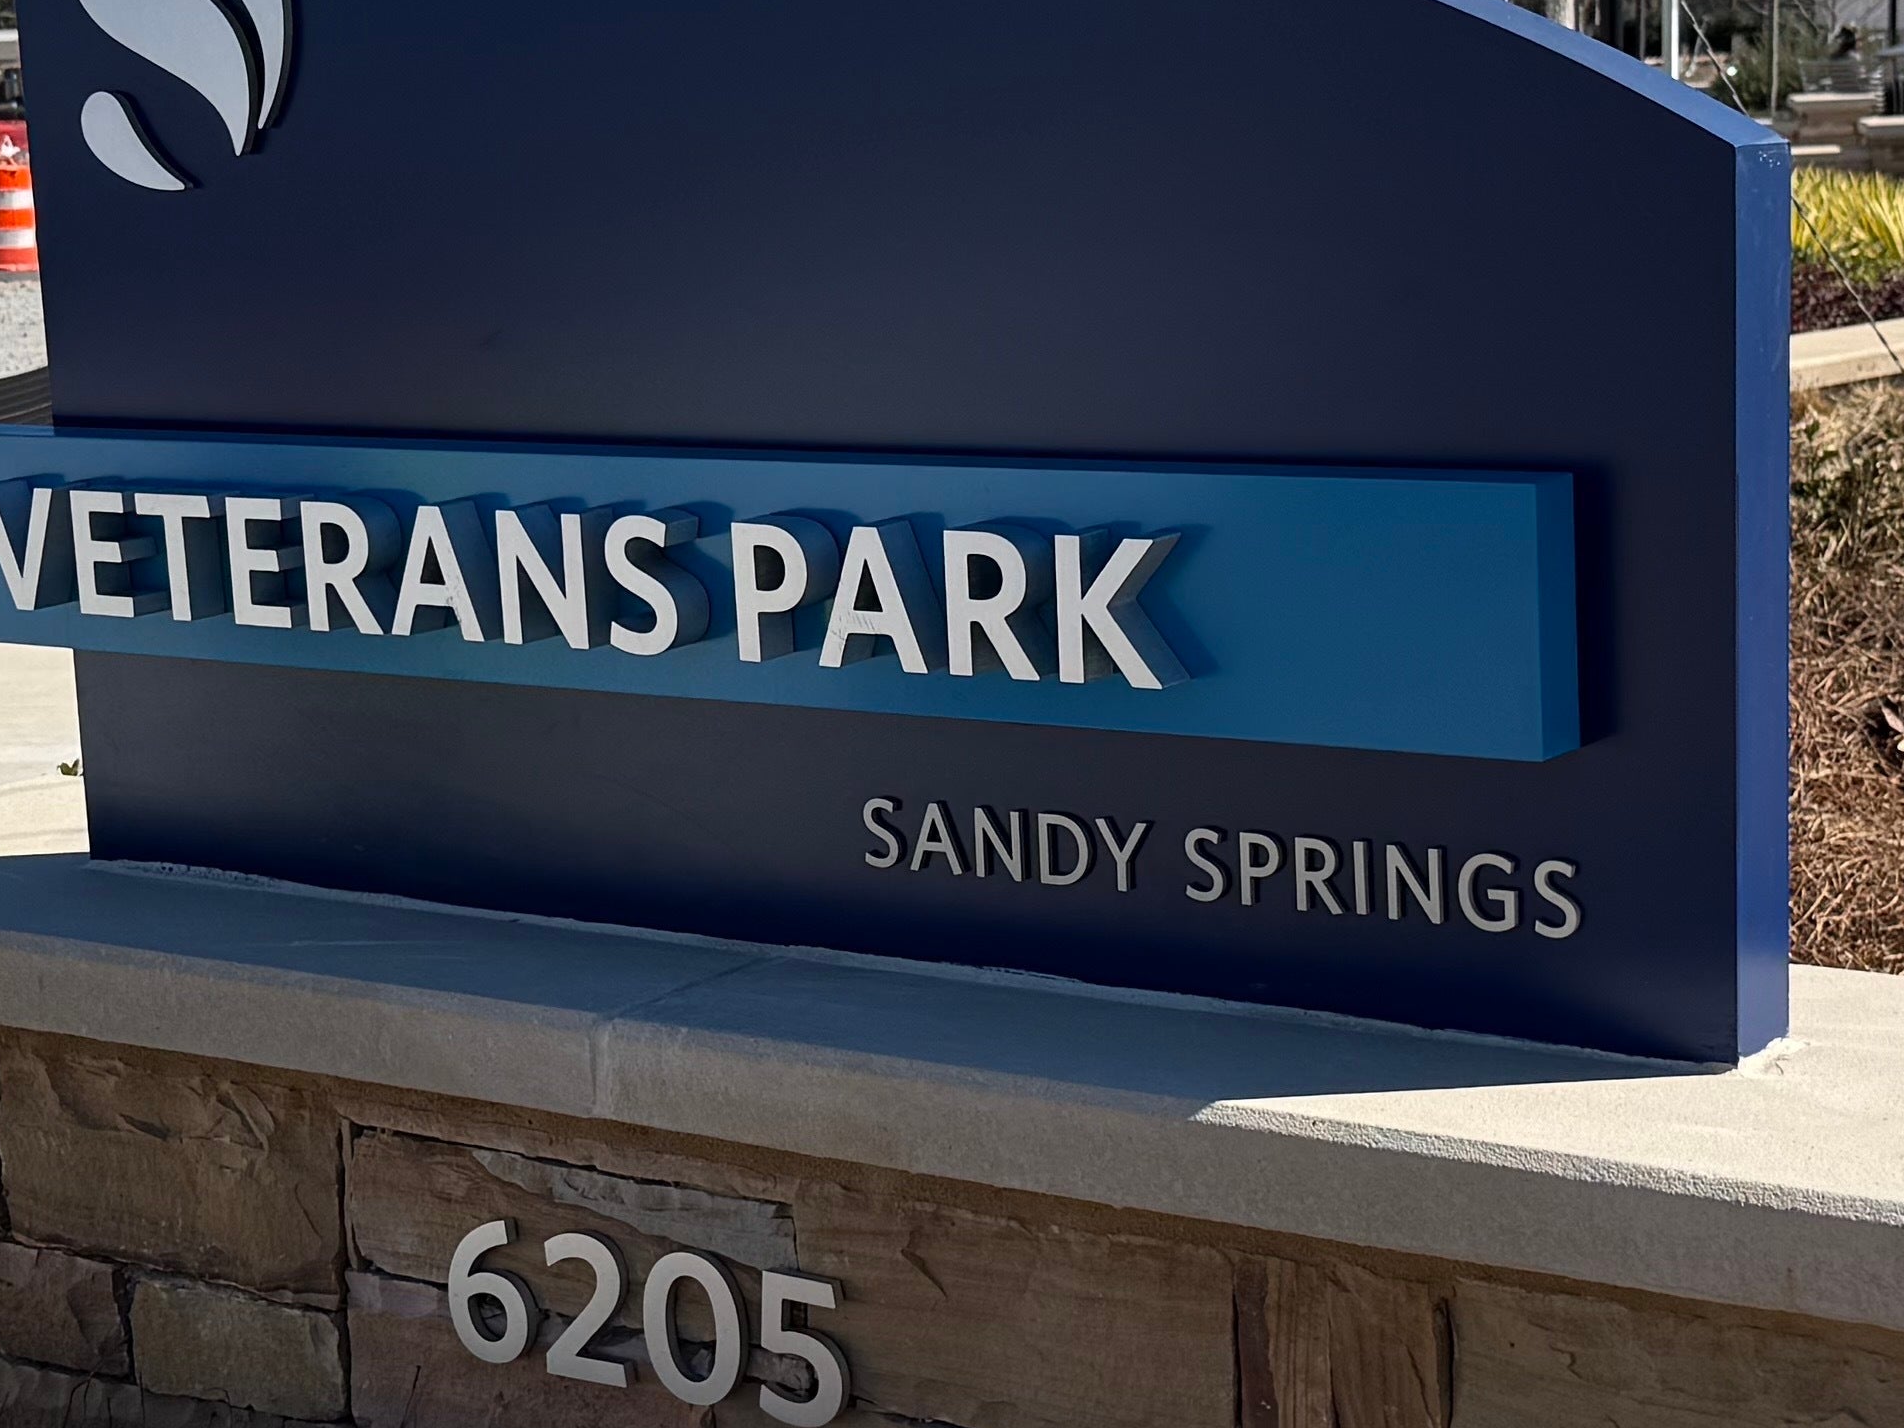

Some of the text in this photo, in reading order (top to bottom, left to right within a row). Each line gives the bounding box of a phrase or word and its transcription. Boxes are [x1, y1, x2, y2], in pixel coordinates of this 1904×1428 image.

[730, 521, 1164, 690] PARK
[862, 796, 1580, 940] SANDY SPRINGS
[447, 1218, 848, 1428] 6205
